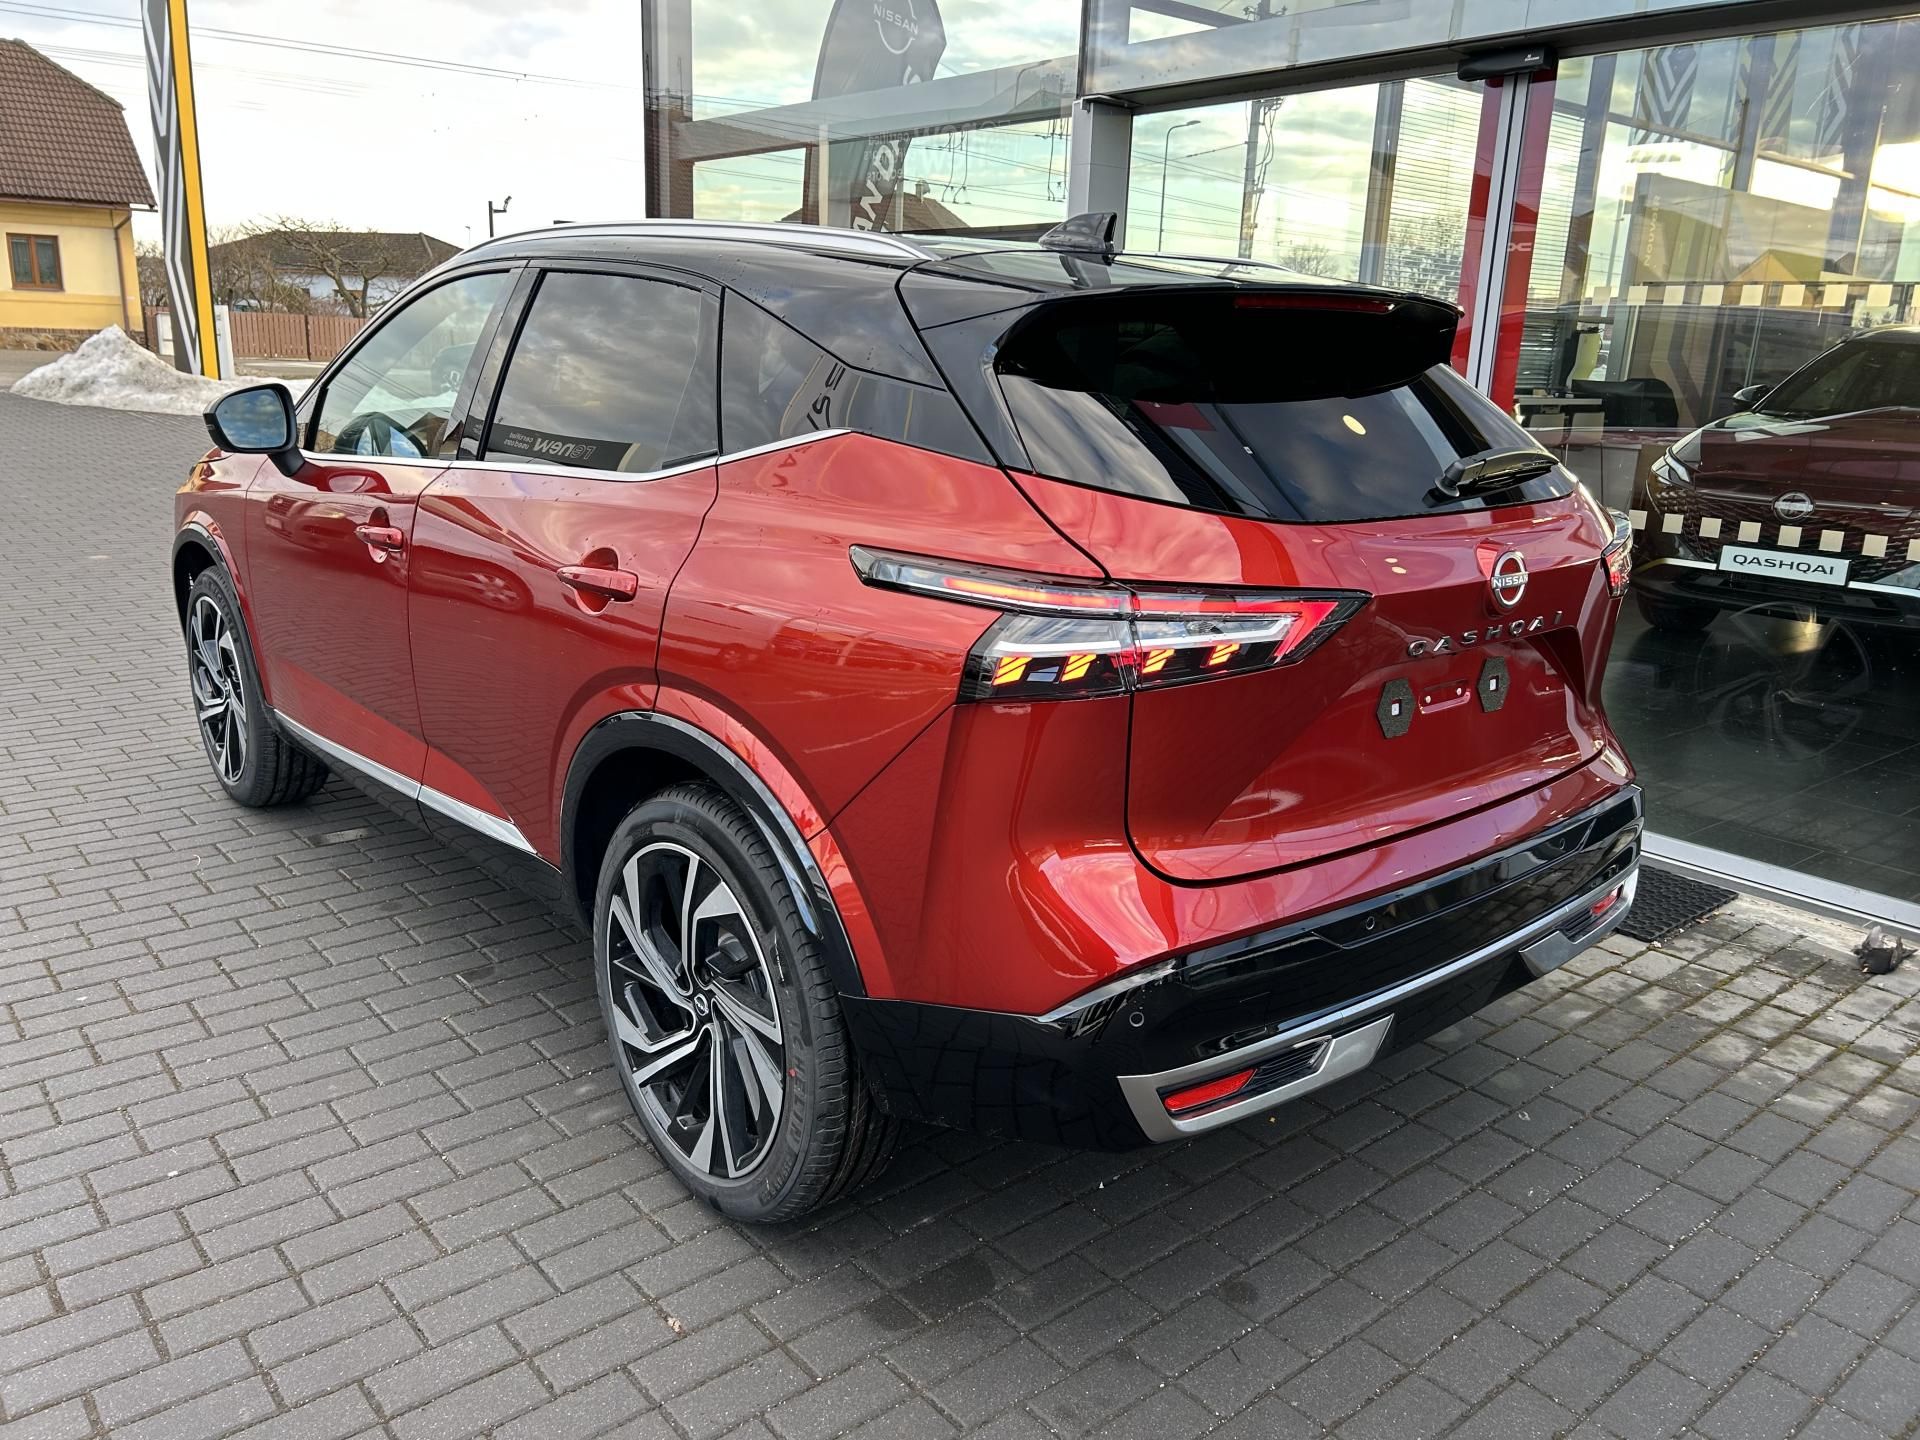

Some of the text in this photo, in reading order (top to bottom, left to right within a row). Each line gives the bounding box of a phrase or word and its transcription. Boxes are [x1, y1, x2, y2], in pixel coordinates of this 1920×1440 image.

[874, 3, 918, 35] NISSAN
[1733, 554, 1834, 575] QASHQAI
[1492, 573, 1529, 589] NISSAN
[1408, 610, 1563, 656] QASHQAI
